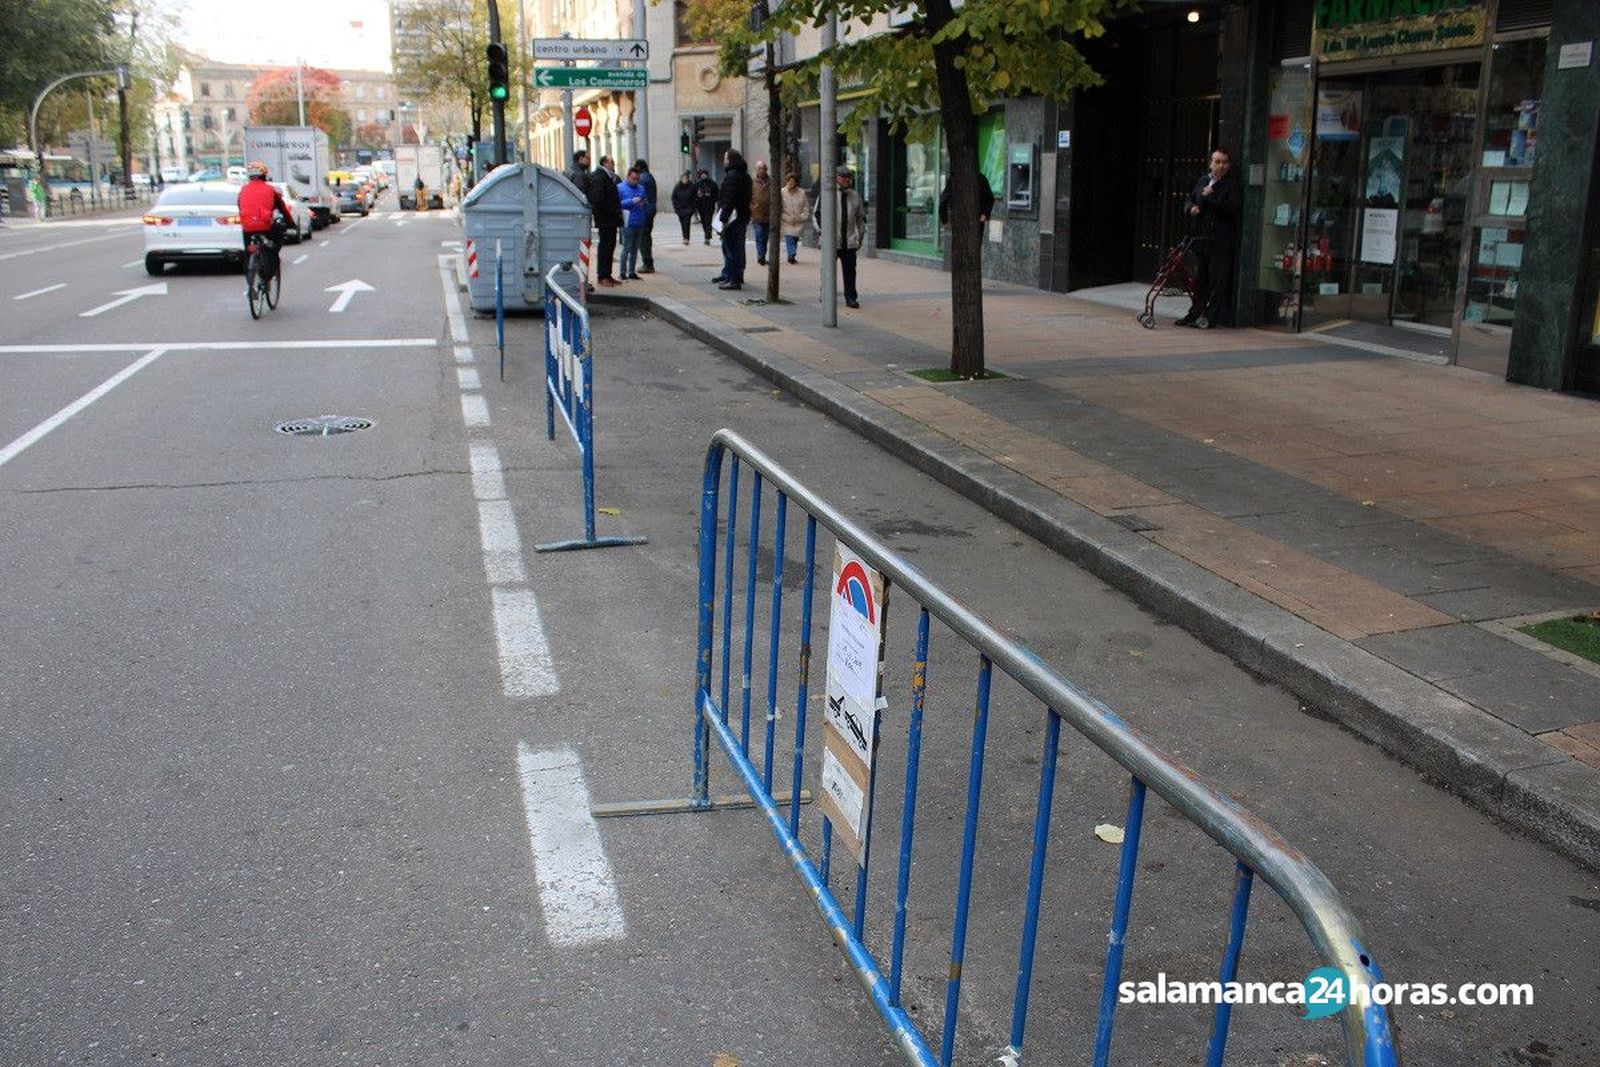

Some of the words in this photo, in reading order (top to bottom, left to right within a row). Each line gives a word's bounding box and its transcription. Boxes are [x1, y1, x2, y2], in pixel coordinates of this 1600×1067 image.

[1316, 0, 1468, 28] FARMA
[536, 44, 569, 54] centro
[573, 43, 608, 54] urbano
[569, 77, 587, 86] Los
[589, 77, 645, 87] Comuneros
